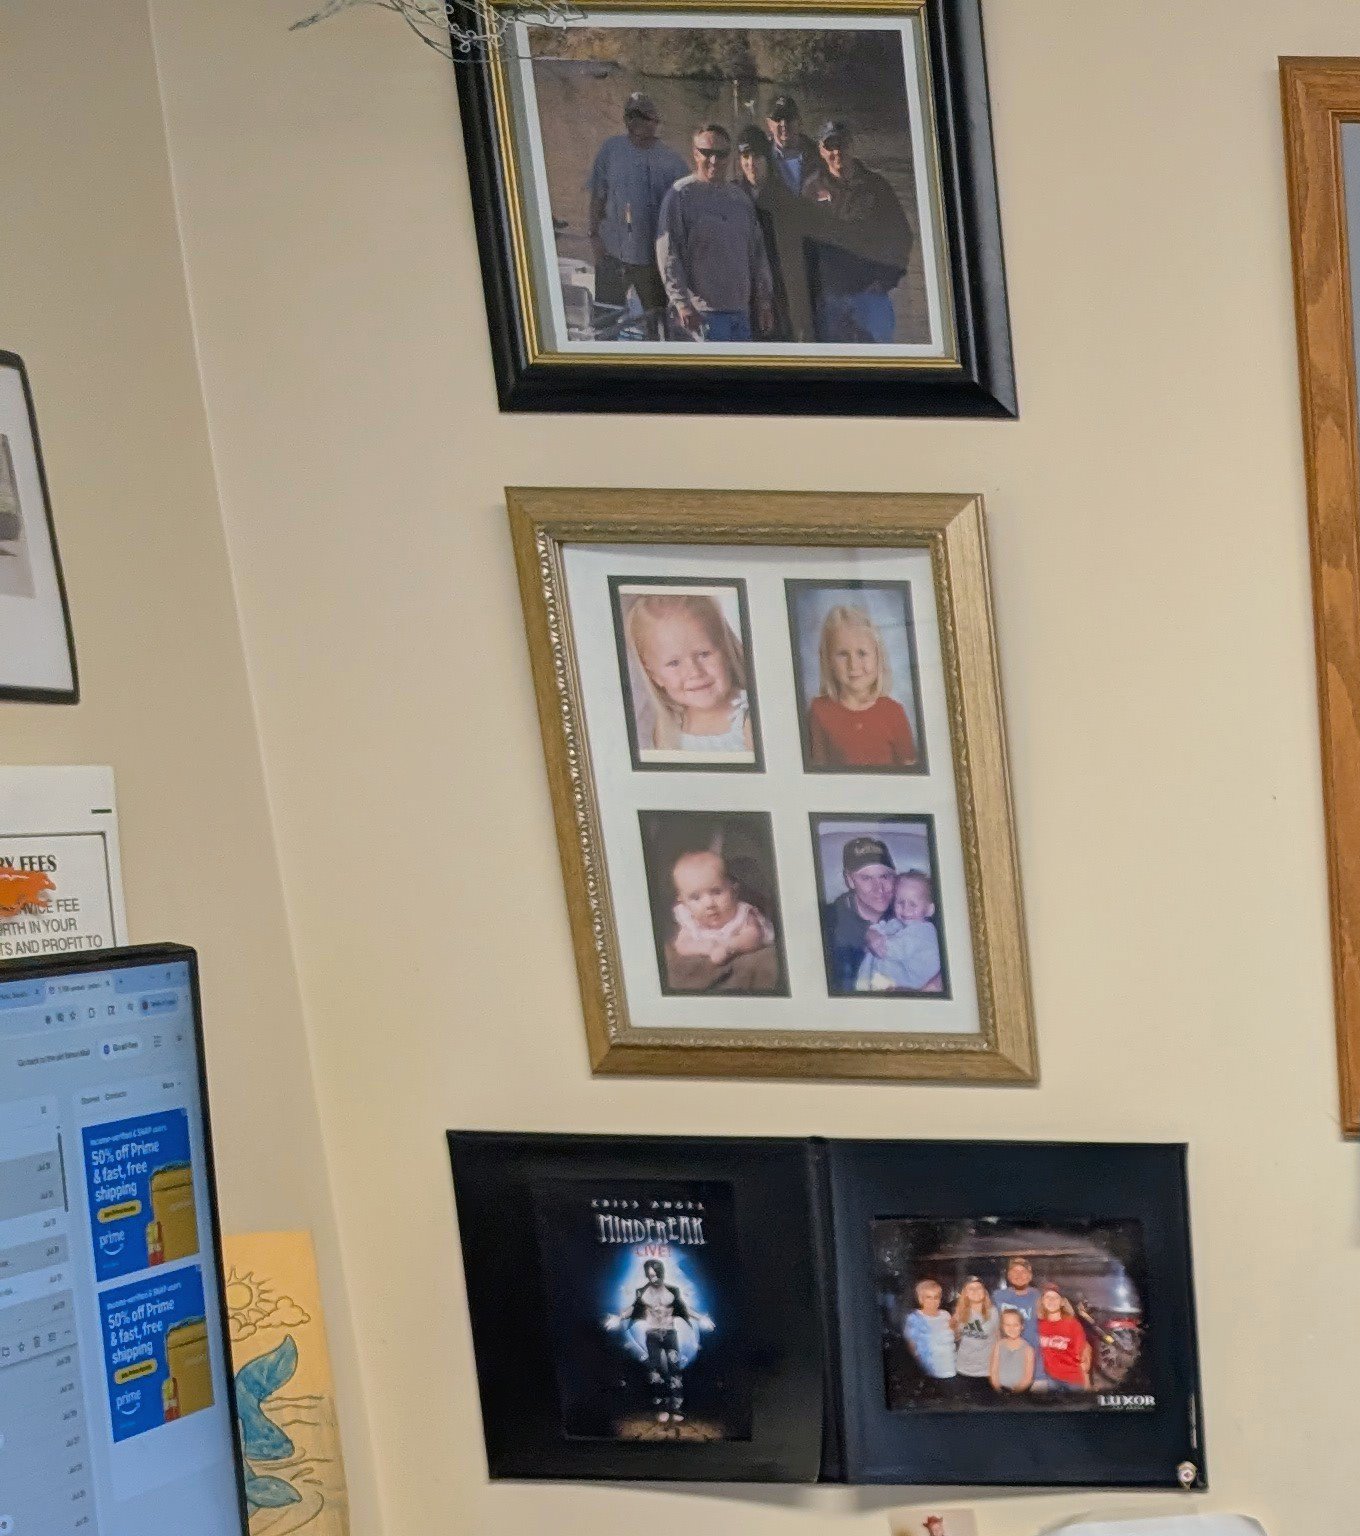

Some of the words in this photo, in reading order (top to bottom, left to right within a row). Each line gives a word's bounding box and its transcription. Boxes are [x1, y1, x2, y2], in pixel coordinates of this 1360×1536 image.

[20, 855, 57, 872] FEES
[57, 898, 80, 912] FEE
[31, 920, 42, 934] IN
[43, 918, 78, 932] YOUR
[15, 940, 40, 954] AND
[42, 936, 83, 951] PROFIT
[86, 935, 103, 947] TO
[91, 1151, 115, 1166] 50%
[115, 1147, 130, 1162] off
[131, 1141, 159, 1160] Prime
[127, 1162, 147, 1176] free
[96, 1181, 138, 1203] shipping
[147, 1299, 175, 1320] Prime
[143, 1321, 164, 1337] free
[1098, 1395, 1156, 1406] LUXOR
